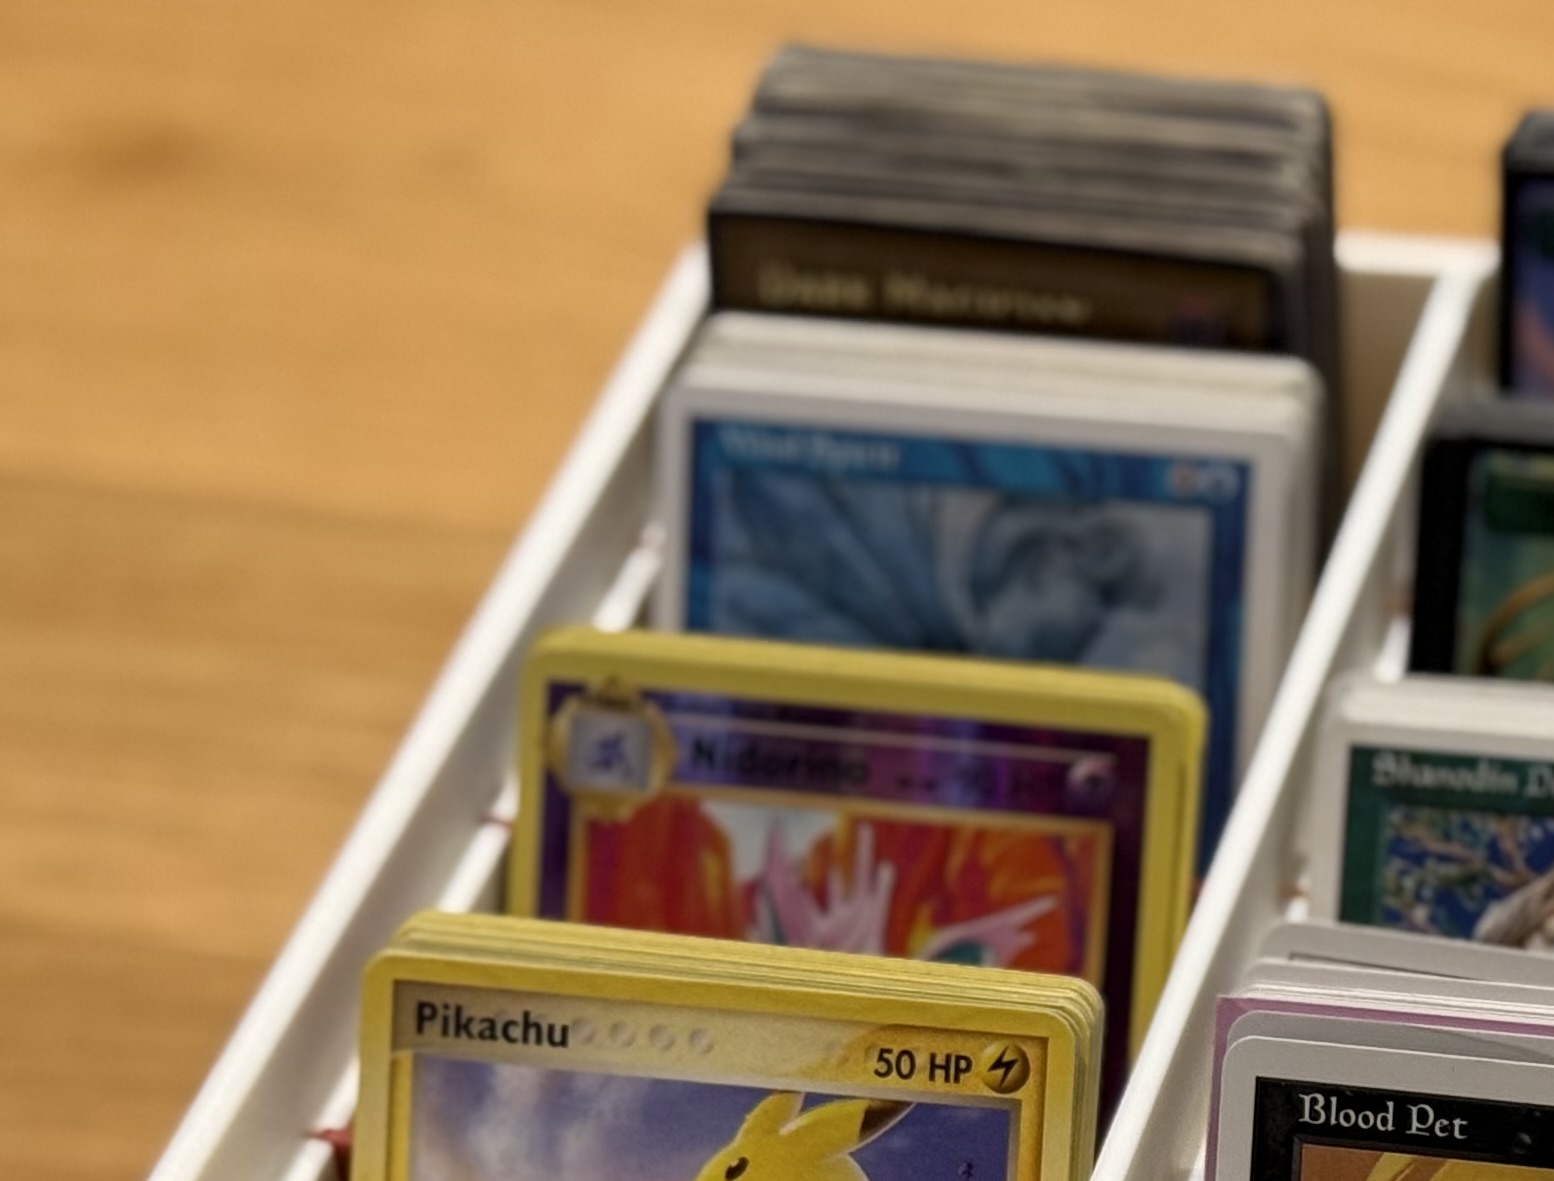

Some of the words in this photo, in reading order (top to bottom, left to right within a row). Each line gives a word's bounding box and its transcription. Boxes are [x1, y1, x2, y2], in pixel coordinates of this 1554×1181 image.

[416, 1001, 570, 1049] Pikachu
[873, 1048, 917, 1081] 50
[929, 1053, 973, 1085] HP
[1298, 1093, 1395, 1133] Blood
[1405, 1111, 1469, 1140] Pet
